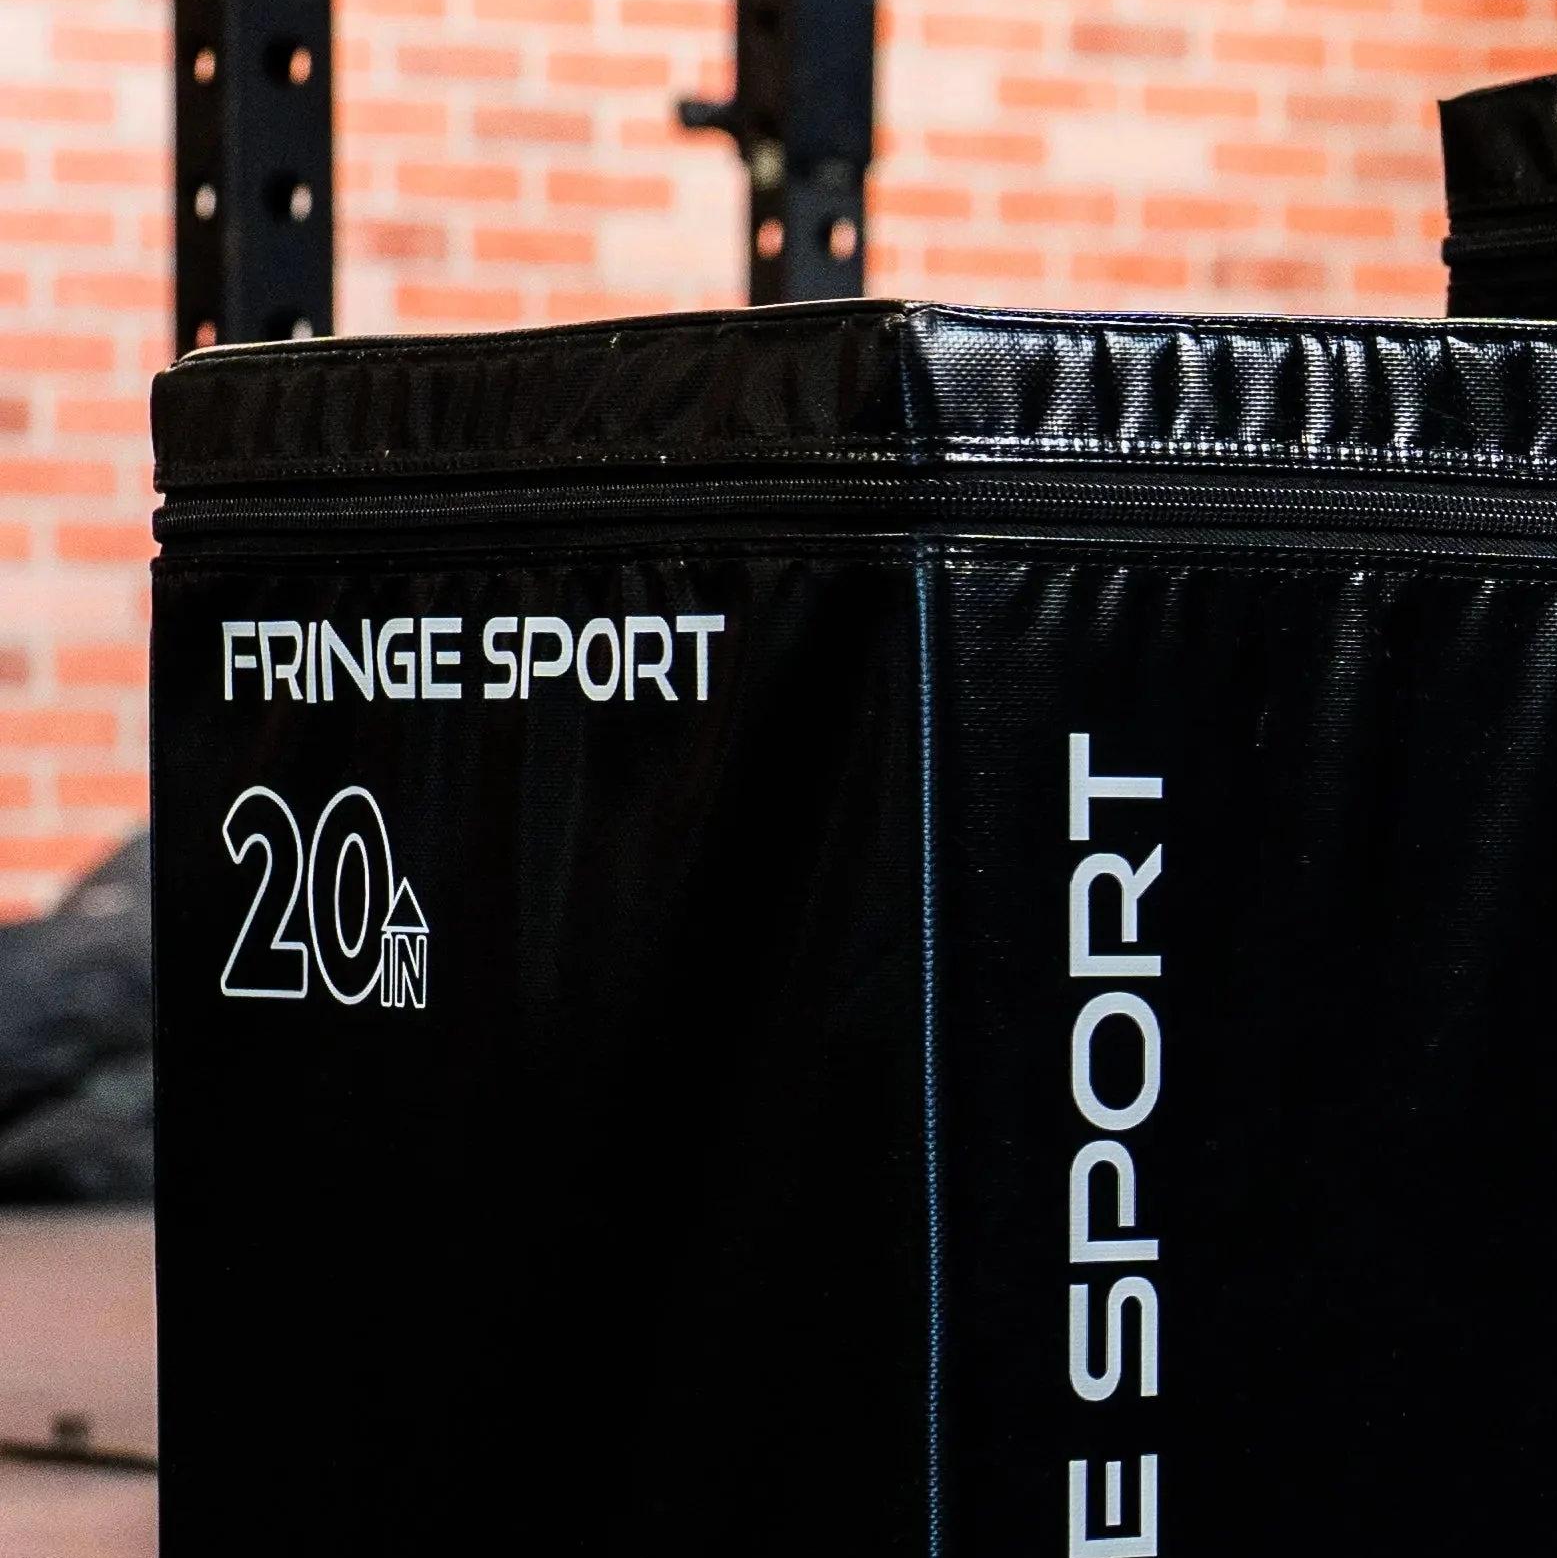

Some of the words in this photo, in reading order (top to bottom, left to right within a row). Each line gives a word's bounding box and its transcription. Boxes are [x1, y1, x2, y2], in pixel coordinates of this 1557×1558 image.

[220, 615, 464, 705] FRINGE
[481, 613, 727, 703] SPORT
[1067, 731, 1165, 1403] SPORT
